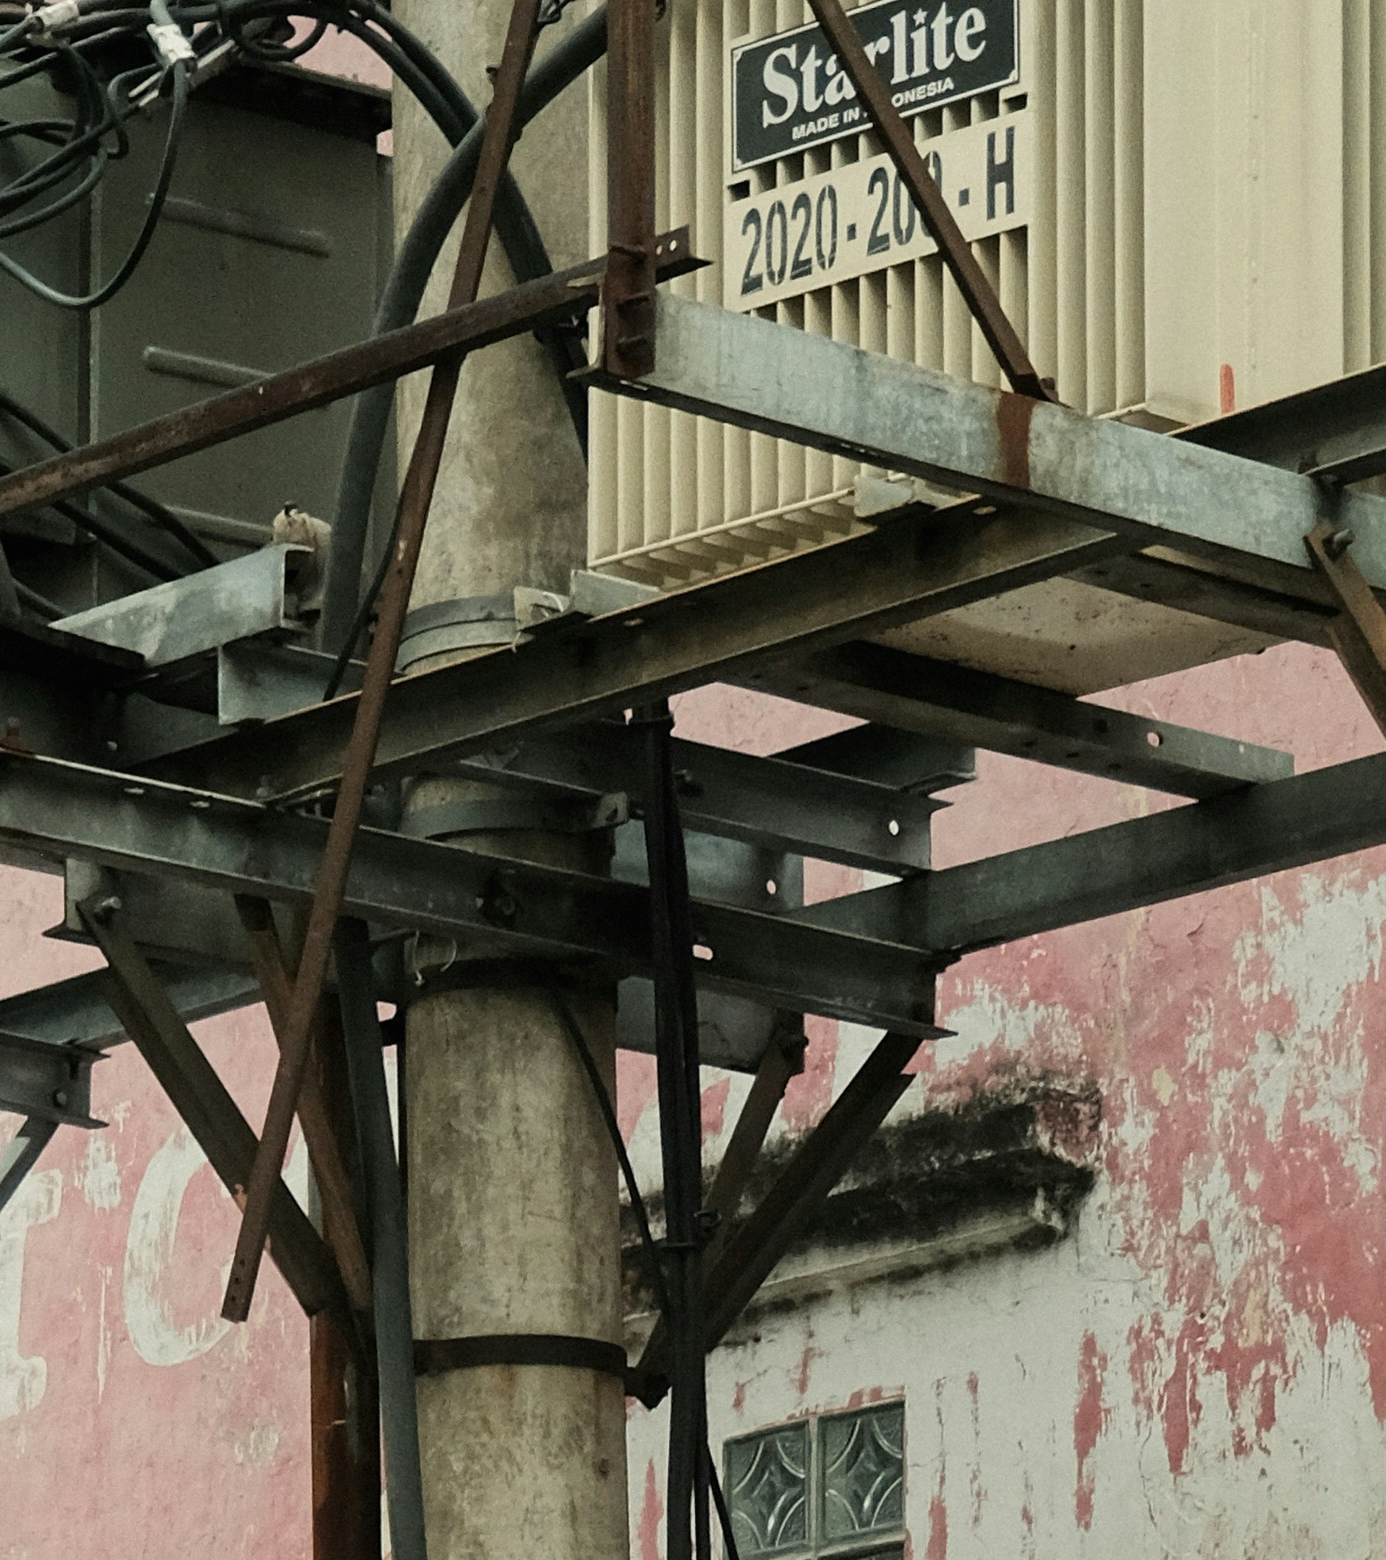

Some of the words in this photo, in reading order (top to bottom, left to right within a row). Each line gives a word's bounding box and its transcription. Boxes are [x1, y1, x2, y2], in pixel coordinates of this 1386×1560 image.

[763, 1, 987, 128] Starlite
[791, 114, 840, 141] MADE
[843, 106, 861, 122] IN
